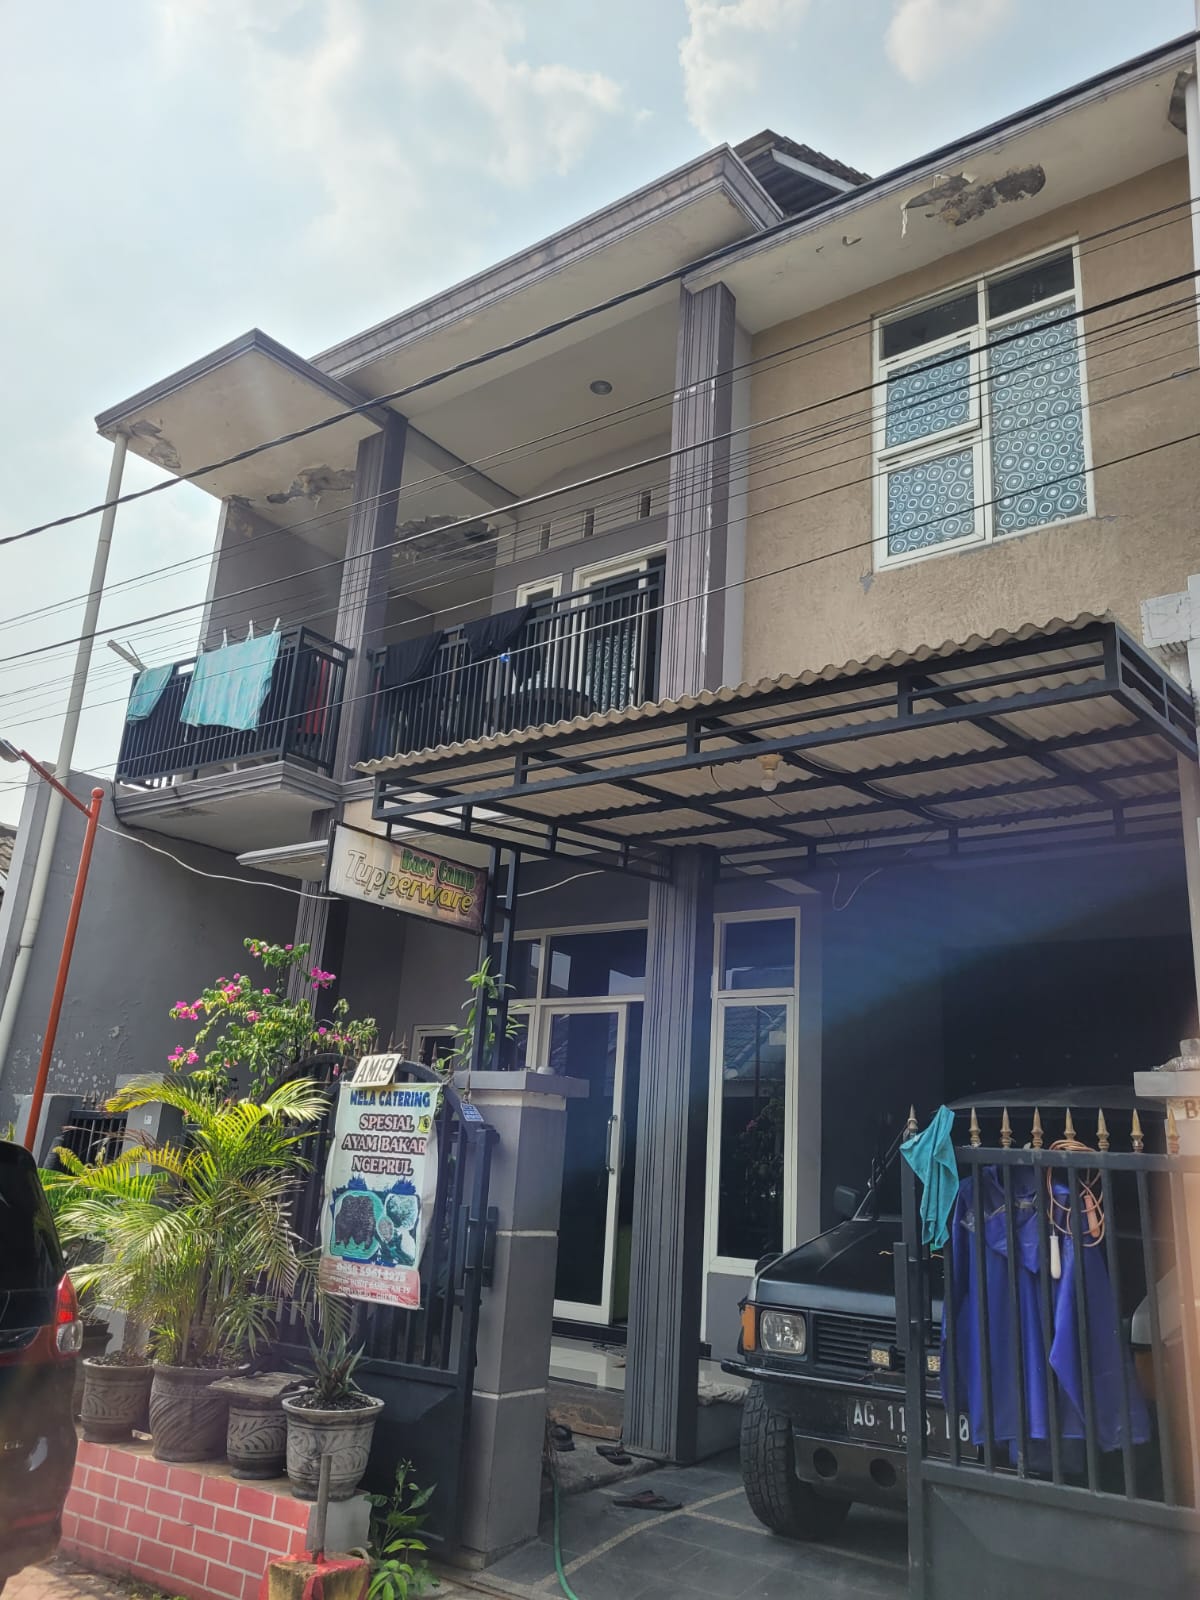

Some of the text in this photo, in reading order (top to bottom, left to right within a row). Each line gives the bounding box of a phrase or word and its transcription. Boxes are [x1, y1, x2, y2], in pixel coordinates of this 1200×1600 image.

[346, 850, 475, 914] Tupperware
[438, 860, 476, 892] Camp
[379, 1090, 431, 1108] CATERING
[359, 1113, 415, 1132] SPESIAL
[342, 1134, 427, 1156] AYAM BAKAR
[351, 1155, 414, 1177] NGEPRUL
